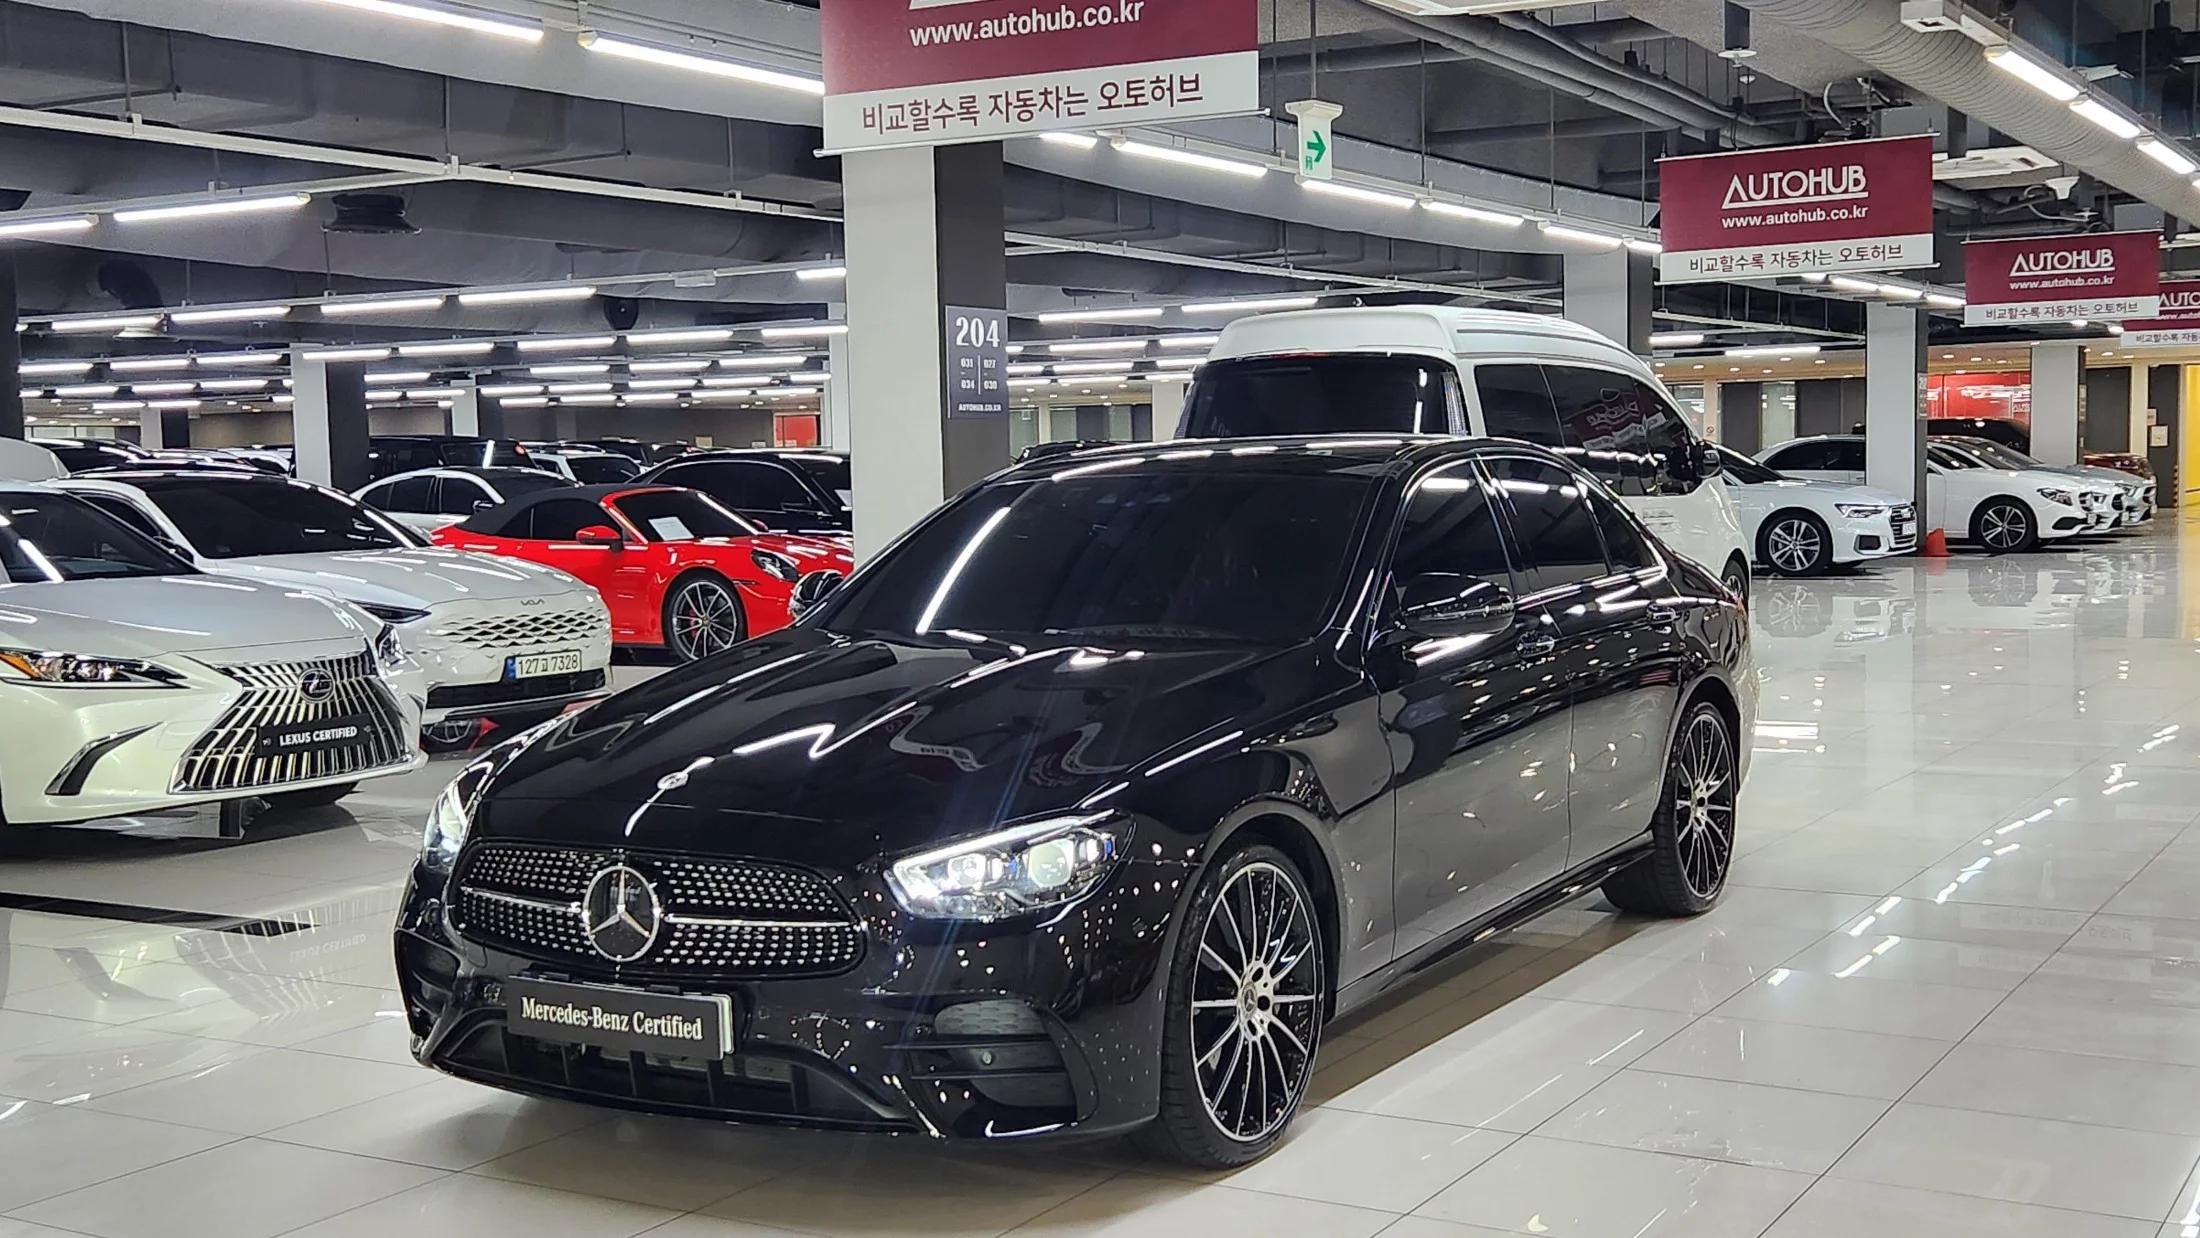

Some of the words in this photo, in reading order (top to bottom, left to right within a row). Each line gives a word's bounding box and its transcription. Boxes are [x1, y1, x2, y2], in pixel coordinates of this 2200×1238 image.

[909, 0, 1145, 47] www.autohub.co.kr
[862, 95, 980, 136] 비교할수록
[988, 86, 1089, 124] 자동차는
[1097, 73, 1204, 112] 오토허브
[1721, 165, 1869, 209] AUTOHUB
[1721, 204, 1869, 229] www.autohub.co.kr
[1690, 252, 1766, 274] 비교할수록
[1770, 248, 1834, 269] 자동차는
[1839, 244, 1904, 264] 오토허브
[2009, 248, 2116, 277] AUTOHUB
[2009, 275, 2115, 291] www.autohub.co.kr
[1985, 305, 2041, 320] 비교할수록
[2044, 303, 2089, 318] 자동차는
[2093, 302, 2139, 315] 오토허브
[955, 316, 1001, 348] 204
[551, 654, 579, 672] 7328
[279, 731, 311, 746] LEXUS
[312, 725, 358, 742] CERTIFIED
[521, 996, 630, 1033] Mercedes-Benz
[632, 1010, 704, 1041] Certified
